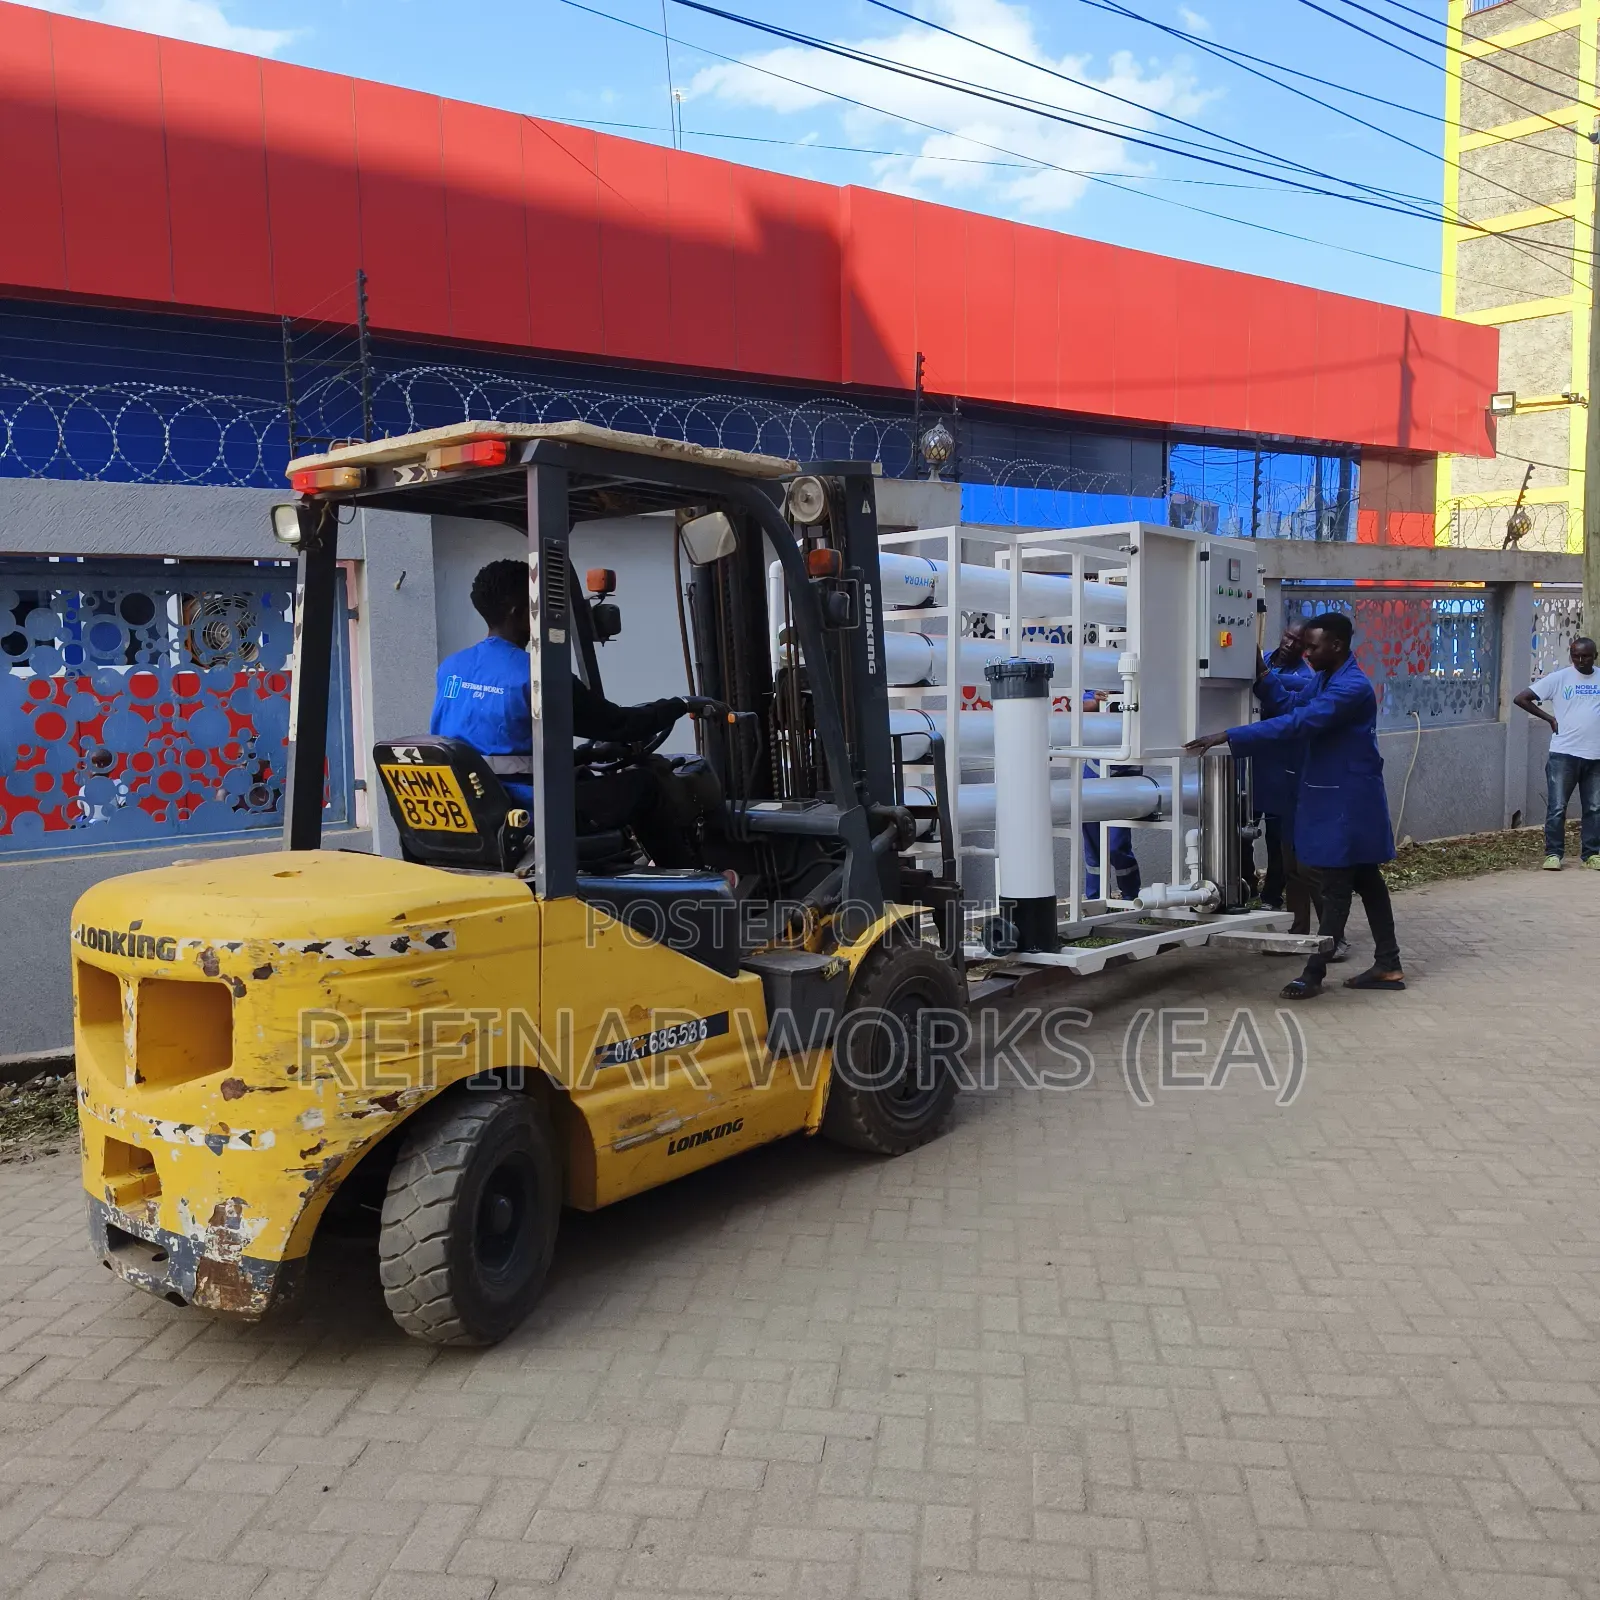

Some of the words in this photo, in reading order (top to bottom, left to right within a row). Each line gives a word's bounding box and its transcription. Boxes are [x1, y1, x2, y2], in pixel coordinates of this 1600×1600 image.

[864, 583, 876, 674] LONKING
[483, 685, 504, 695] WORKS
[387, 769, 454, 798] KHMA
[403, 798, 468, 828] 839B
[81, 919, 177, 961] LONKING
[667, 1117, 744, 1156] LONKING
